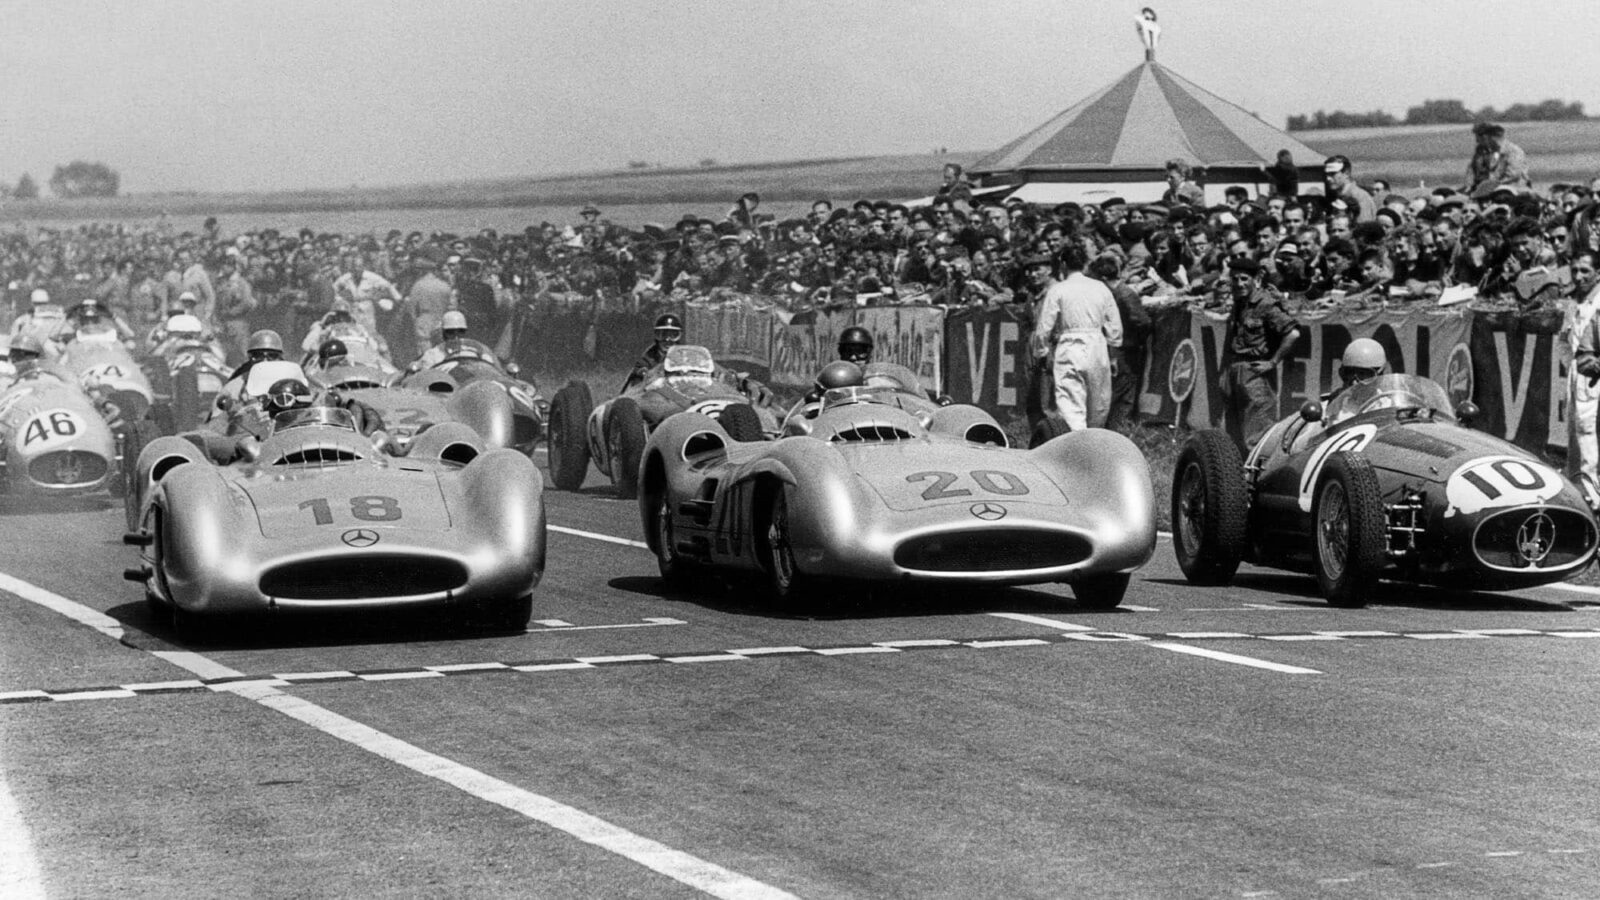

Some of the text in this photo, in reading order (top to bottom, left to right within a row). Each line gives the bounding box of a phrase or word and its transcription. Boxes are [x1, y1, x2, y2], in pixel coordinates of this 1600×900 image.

[965, 322, 1162, 415] VEL
[24, 412, 76, 446] 46
[905, 470, 1030, 501] 20
[1461, 460, 1546, 500] 10
[298, 496, 402, 525] 18
